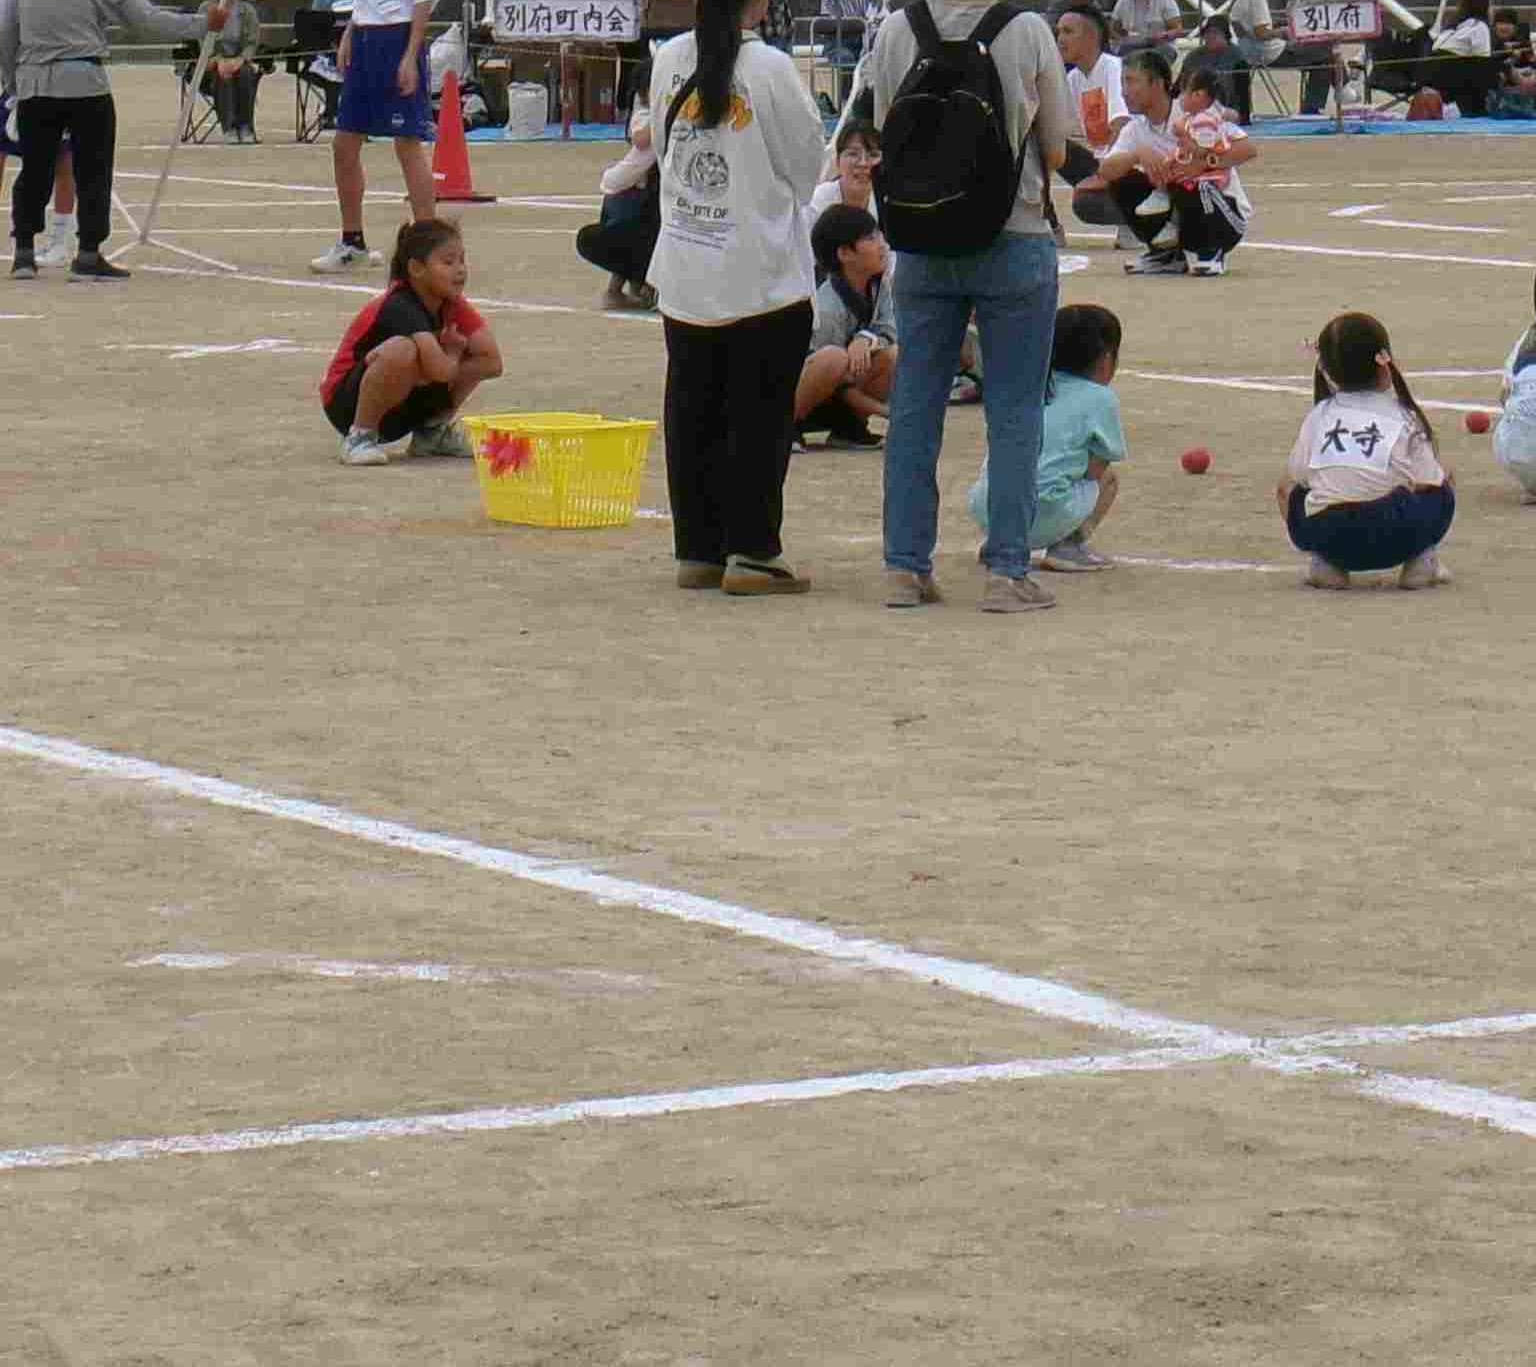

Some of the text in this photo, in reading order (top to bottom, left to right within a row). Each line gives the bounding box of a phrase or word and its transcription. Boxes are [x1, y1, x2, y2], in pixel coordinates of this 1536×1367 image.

[504, 3, 631, 33] 別府町内会
[1303, 4, 1361, 31] 別府
[1320, 418, 1385, 459] 大寺
